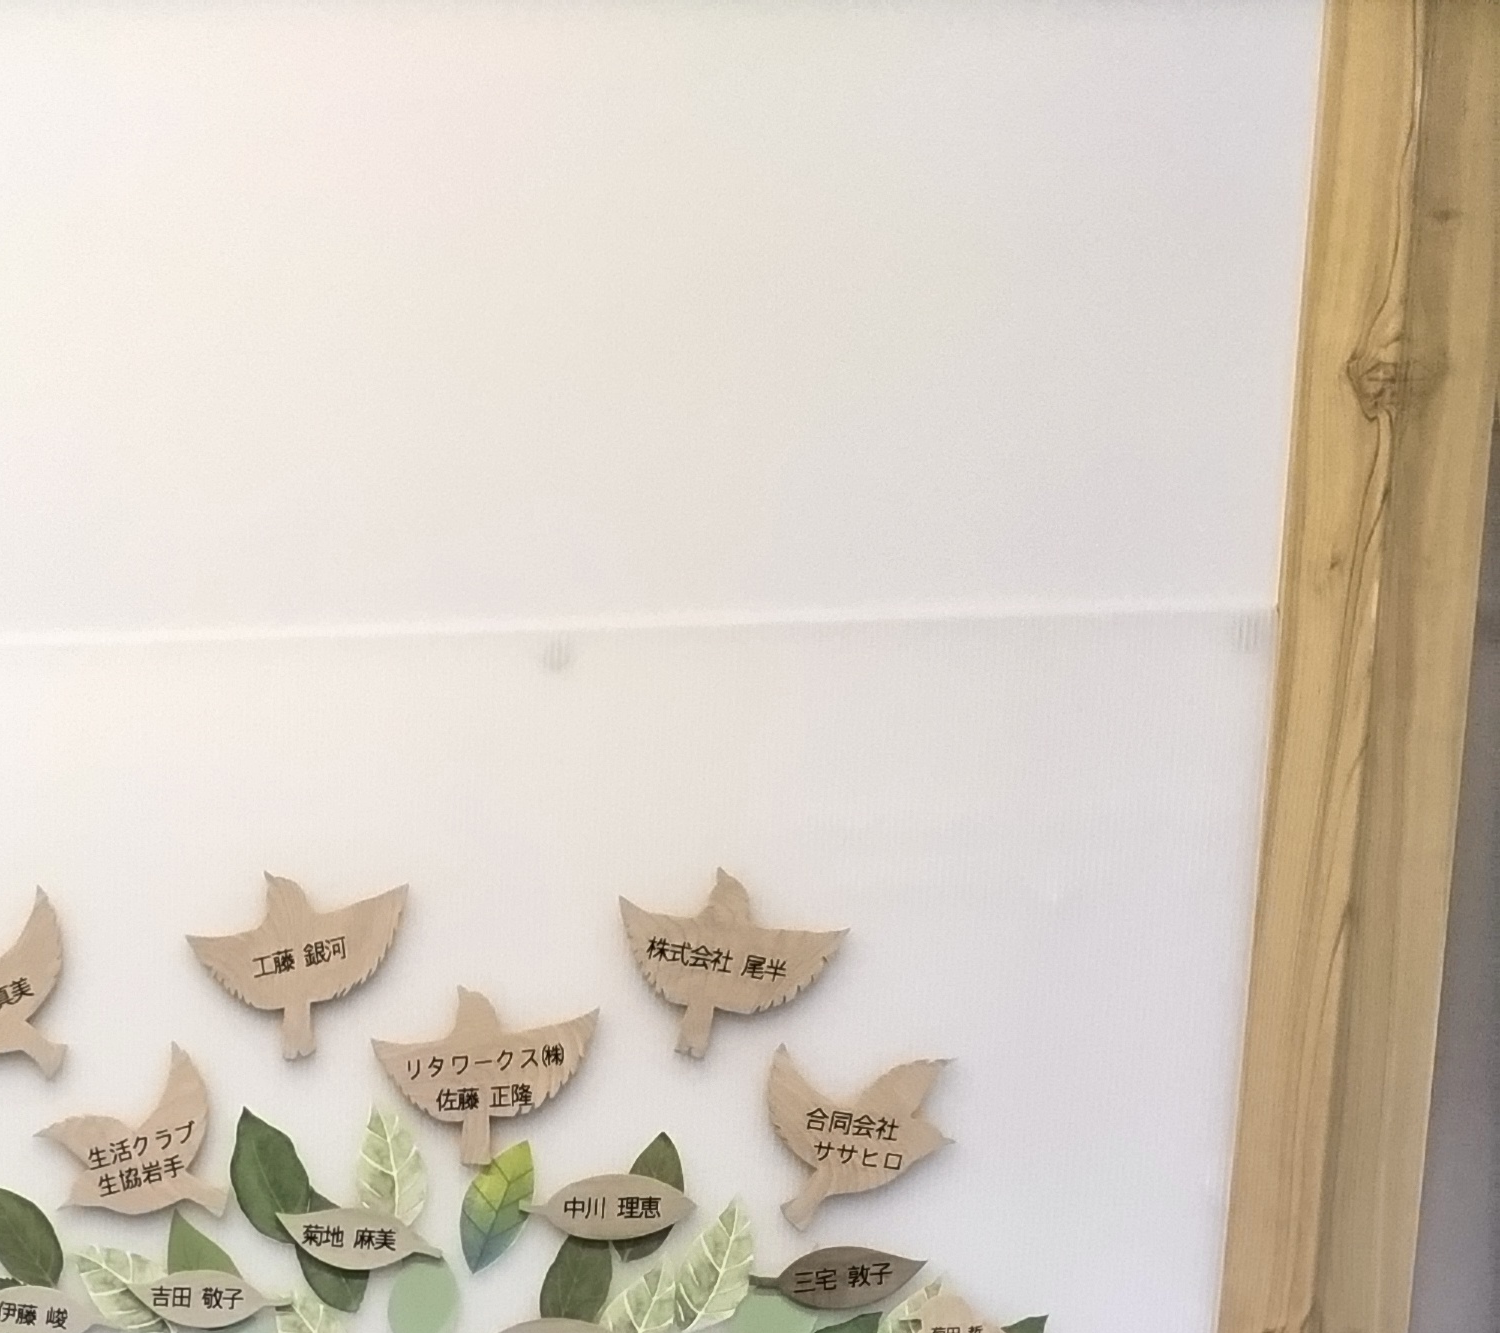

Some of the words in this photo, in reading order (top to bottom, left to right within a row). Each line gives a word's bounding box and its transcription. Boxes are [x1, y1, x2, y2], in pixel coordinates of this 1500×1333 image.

[253, 949, 295, 978] 工藤
[304, 937, 346, 967] 銀河
[647, 937, 733, 973] 株式会社
[741, 955, 786, 981] 尾半
[436, 1088, 479, 1111] 佐藤
[490, 1084, 534, 1108] 正隆
[807, 1108, 899, 1142] 合同会社
[86, 1121, 196, 1170] 生活クラブ
[813, 1141, 902, 1171] ササヒロ
[98, 1156, 185, 1197] 生協岩手
[564, 1197, 605, 1219] 中川
[617, 1197, 661, 1218] 理恵
[302, 1225, 344, 1248] 菊地
[354, 1228, 395, 1251] 麻美
[794, 1268, 837, 1293] 三宅
[848, 1263, 892, 1287] 敦子
[151, 1287, 191, 1307] 吉田
[202, 1287, 243, 1309] 敬子
[46, 1308, 67, 1329] 峻
